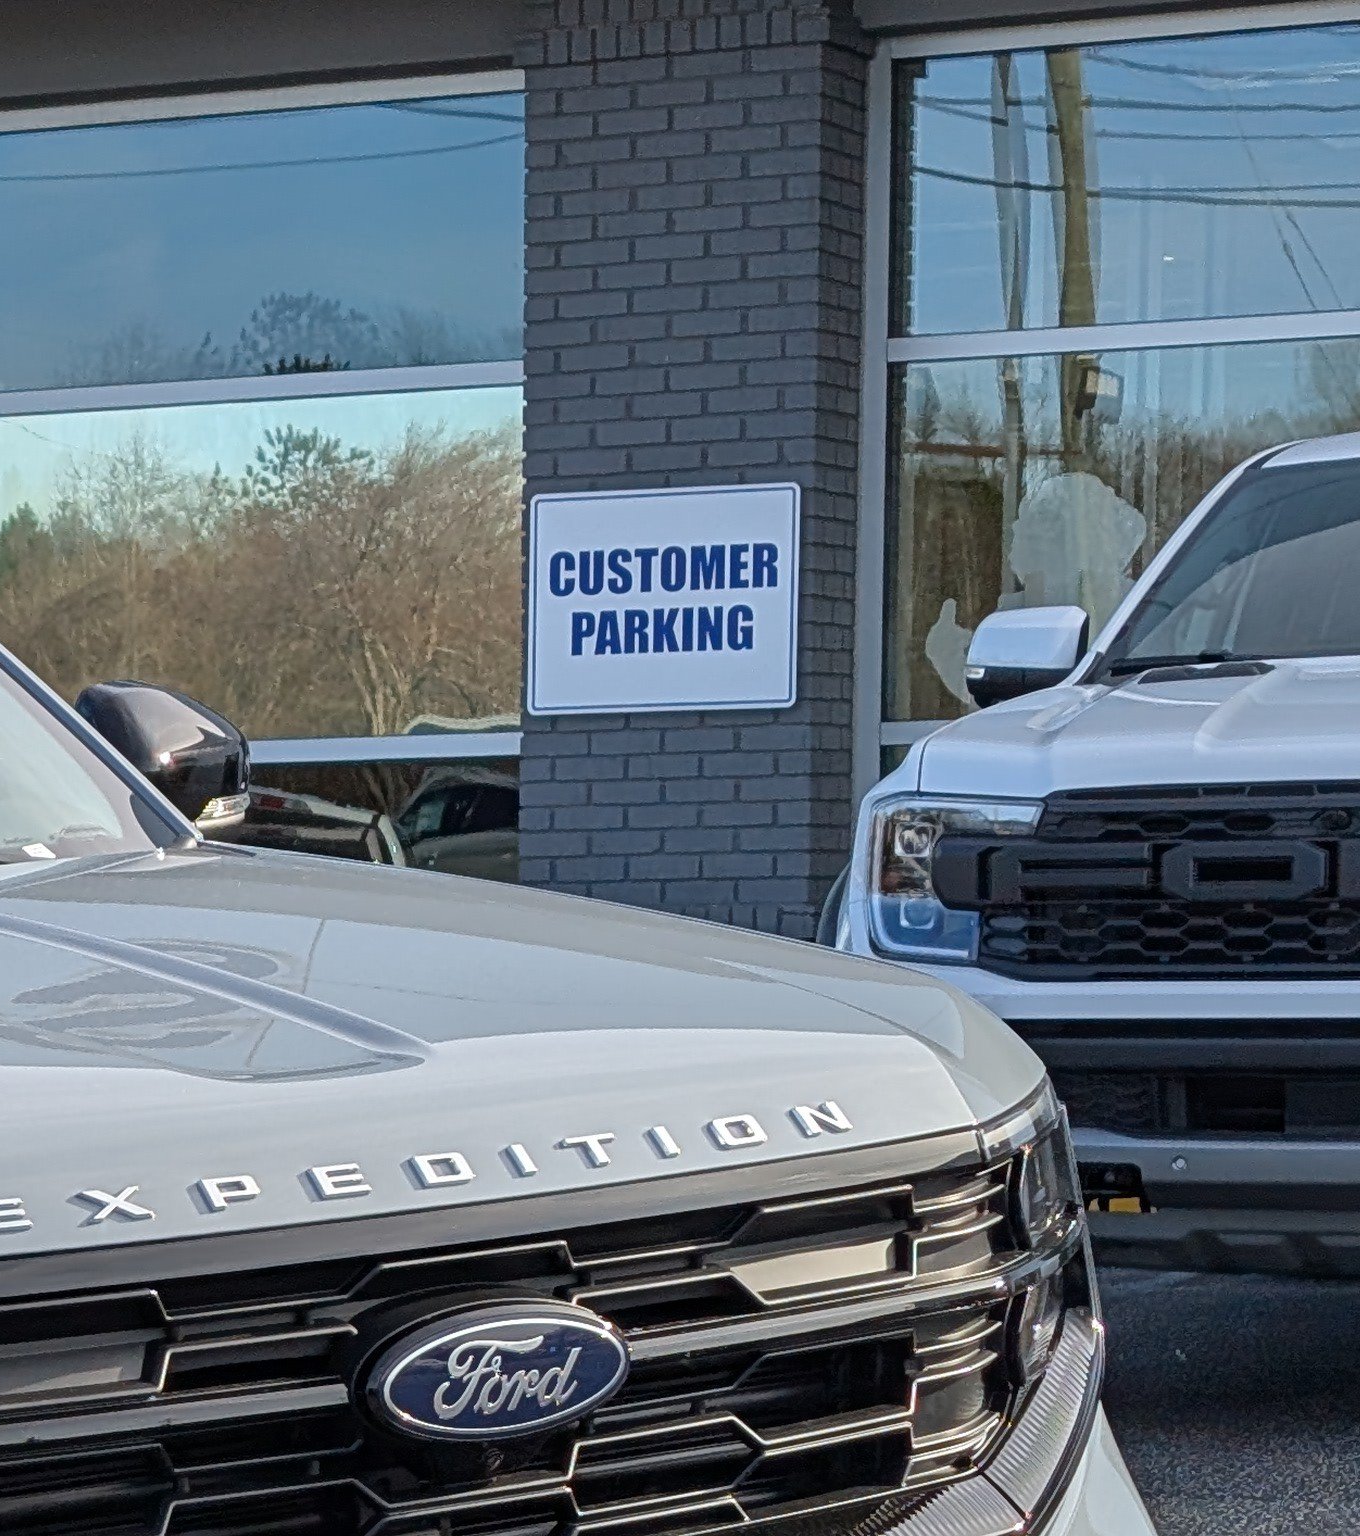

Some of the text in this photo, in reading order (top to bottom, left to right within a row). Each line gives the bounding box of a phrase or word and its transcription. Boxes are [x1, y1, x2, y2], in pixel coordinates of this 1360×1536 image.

[549, 542, 779, 597] CUSTOMER
[570, 604, 754, 657] PARKING
[986, 841, 1360, 903] FO
[433, 1335, 583, 1420] Ford
